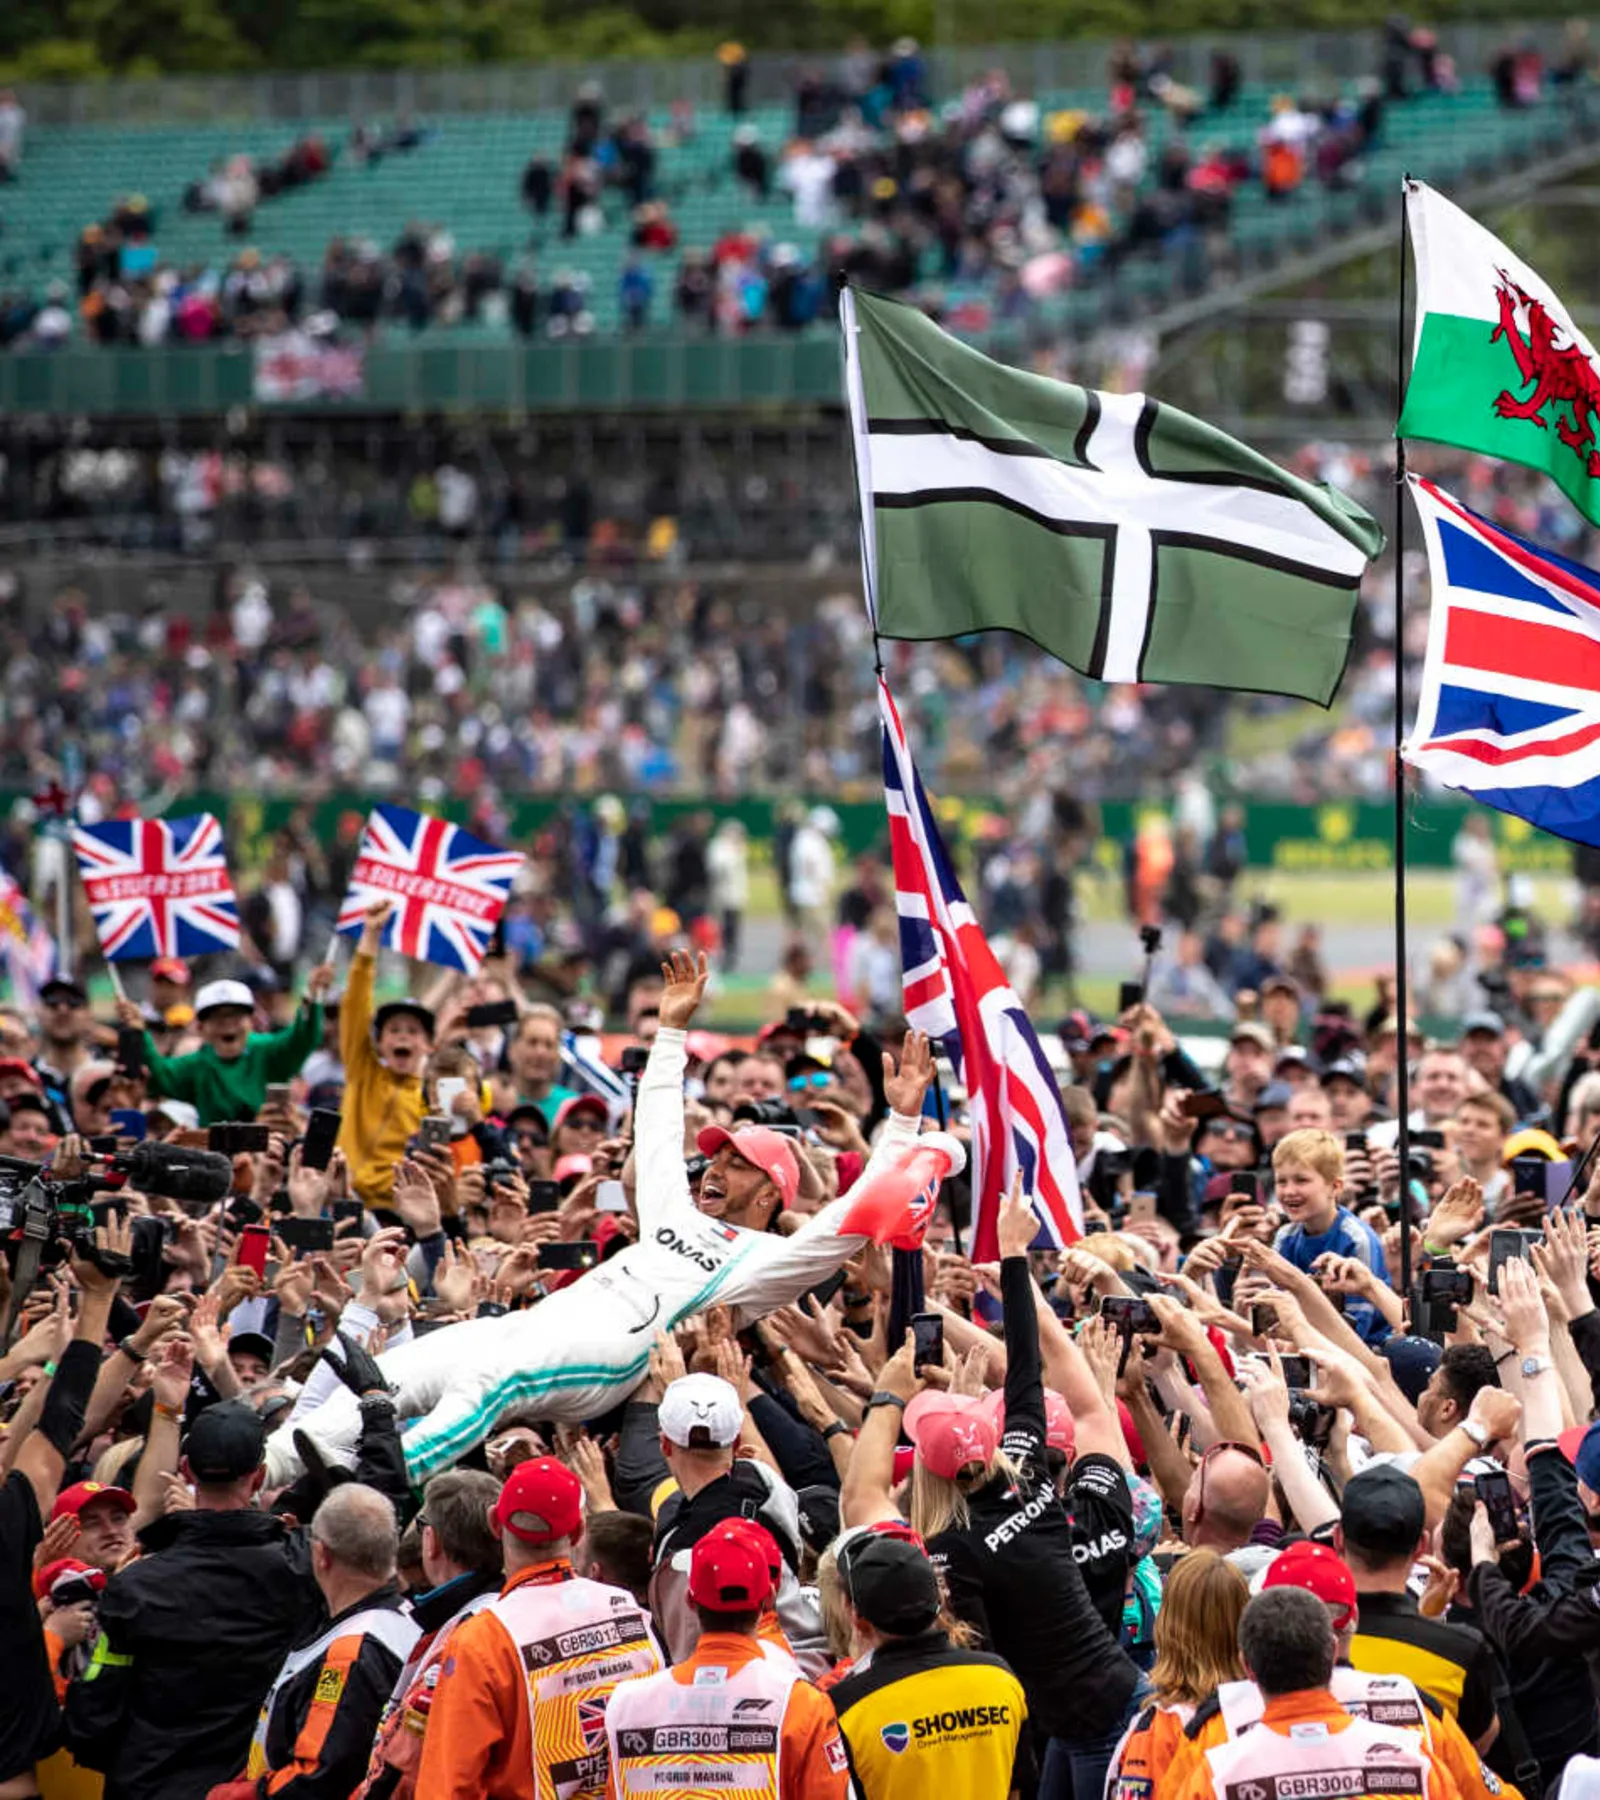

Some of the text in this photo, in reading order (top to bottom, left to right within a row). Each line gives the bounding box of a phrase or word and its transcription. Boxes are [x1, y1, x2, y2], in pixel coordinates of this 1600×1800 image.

[655, 1226, 722, 1272] ONAS
[984, 1476, 1056, 1553] PETRONA
[1071, 1529, 1128, 1564] ONAS
[912, 1706, 1010, 1738] SHOWSEC
[1278, 1770, 1363, 1796] GBR3004
